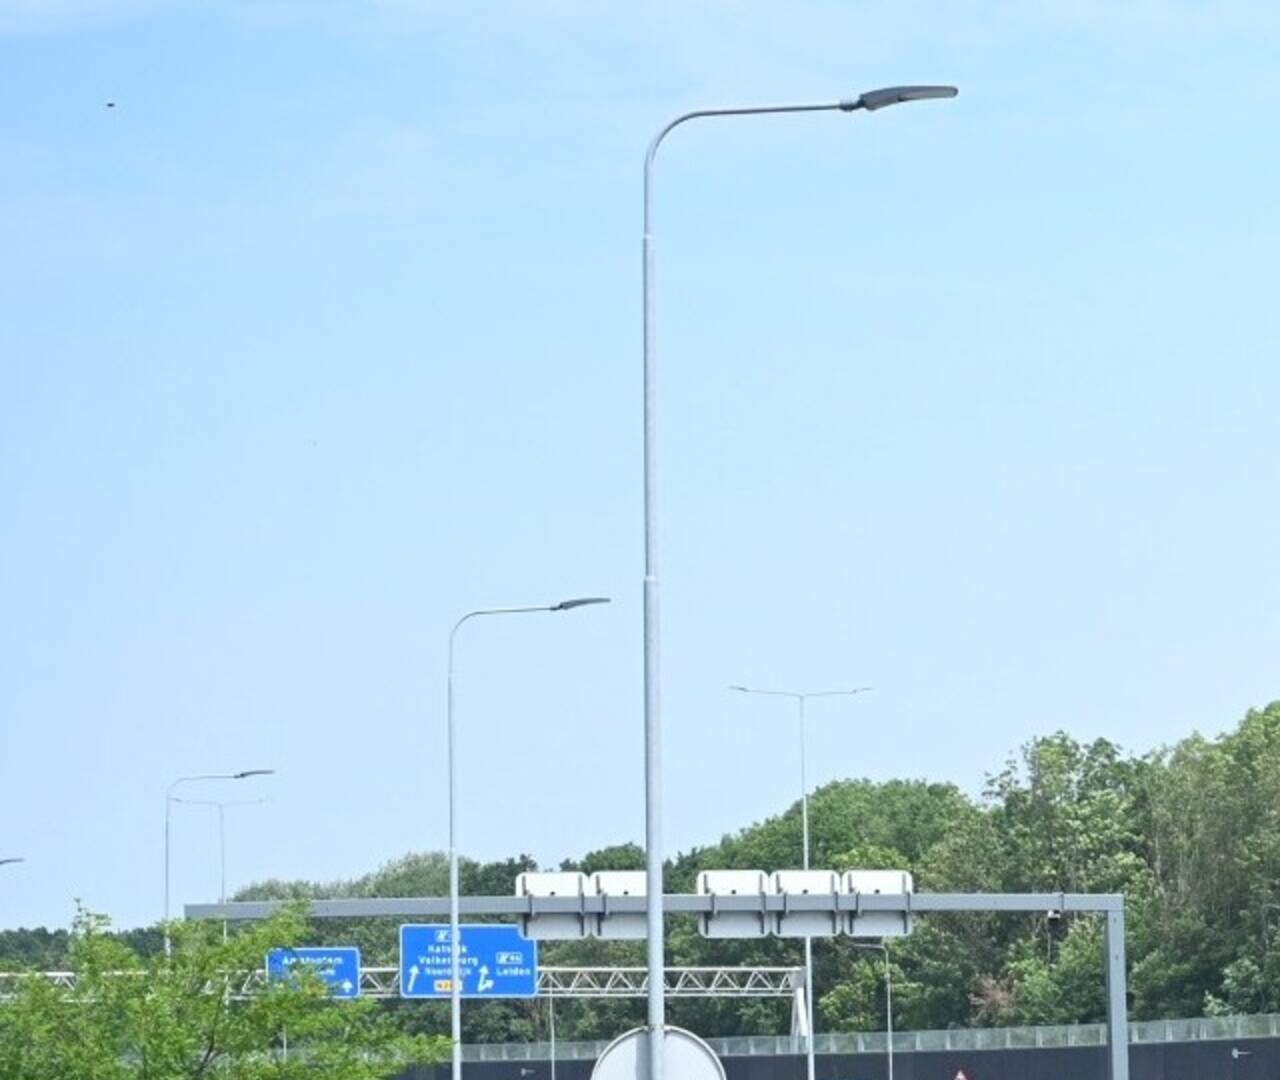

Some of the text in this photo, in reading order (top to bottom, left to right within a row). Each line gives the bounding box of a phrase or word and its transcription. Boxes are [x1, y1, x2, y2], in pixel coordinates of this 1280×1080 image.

[428, 944, 468, 954] Katwk
[418, 954, 479, 967] Valkenurg
[495, 966, 531, 976] Leiden
